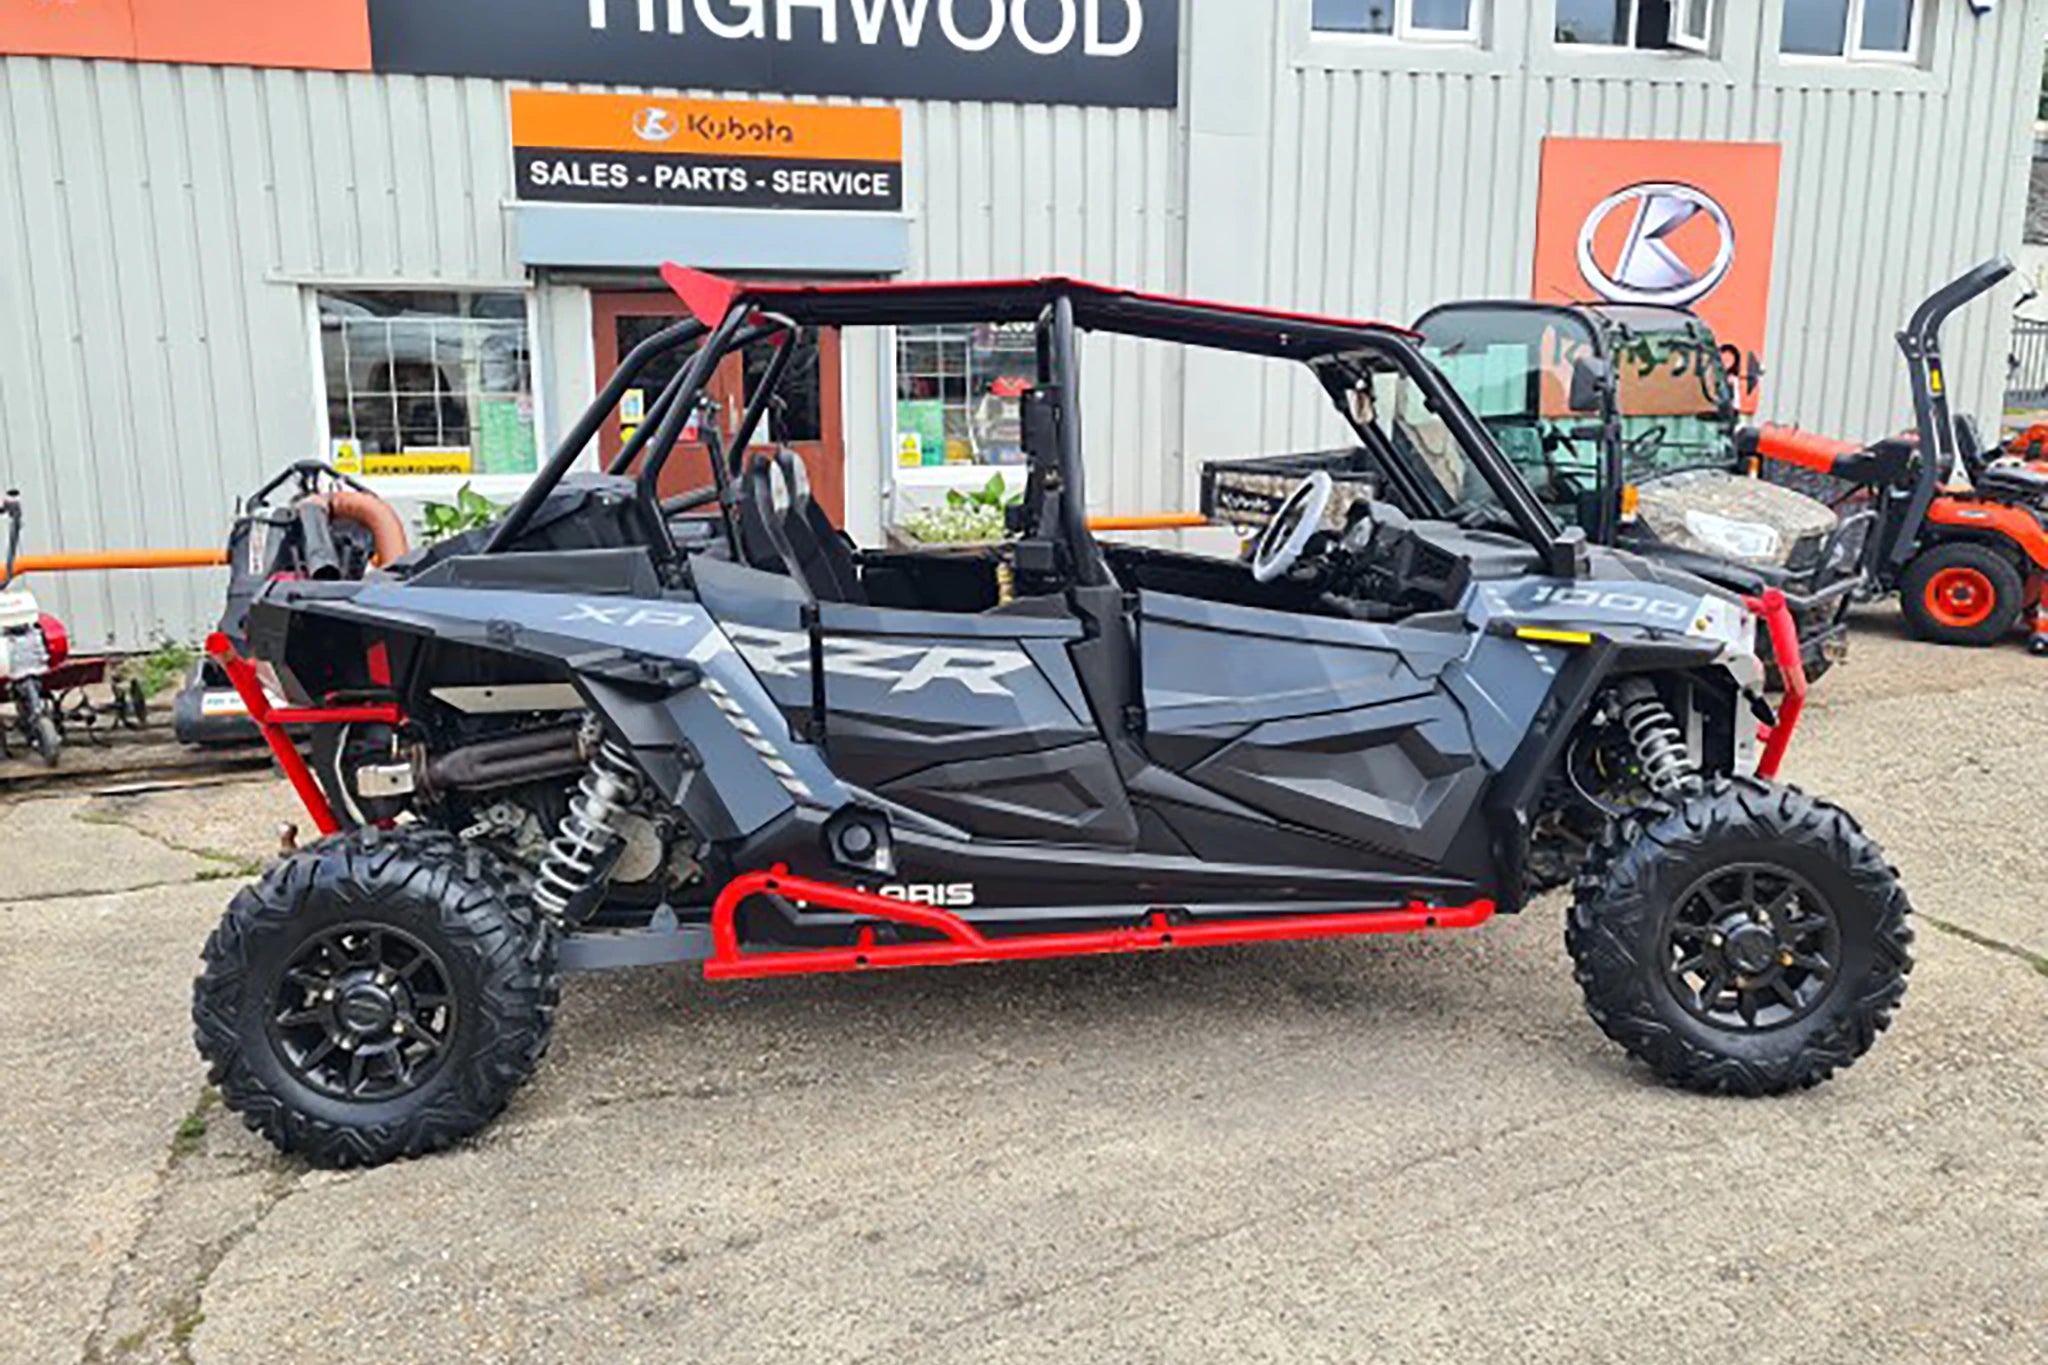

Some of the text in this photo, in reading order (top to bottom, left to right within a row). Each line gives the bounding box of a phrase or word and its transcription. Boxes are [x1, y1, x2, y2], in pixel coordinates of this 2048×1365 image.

[687, 114, 794, 143] Kubota
[530, 161, 628, 187] SALES
[654, 165, 748, 191] PARTS
[771, 169, 890, 196] SERVICE
[558, 602, 695, 627] XP
[1532, 586, 1688, 621] 1000
[685, 620, 1034, 697] RZR
